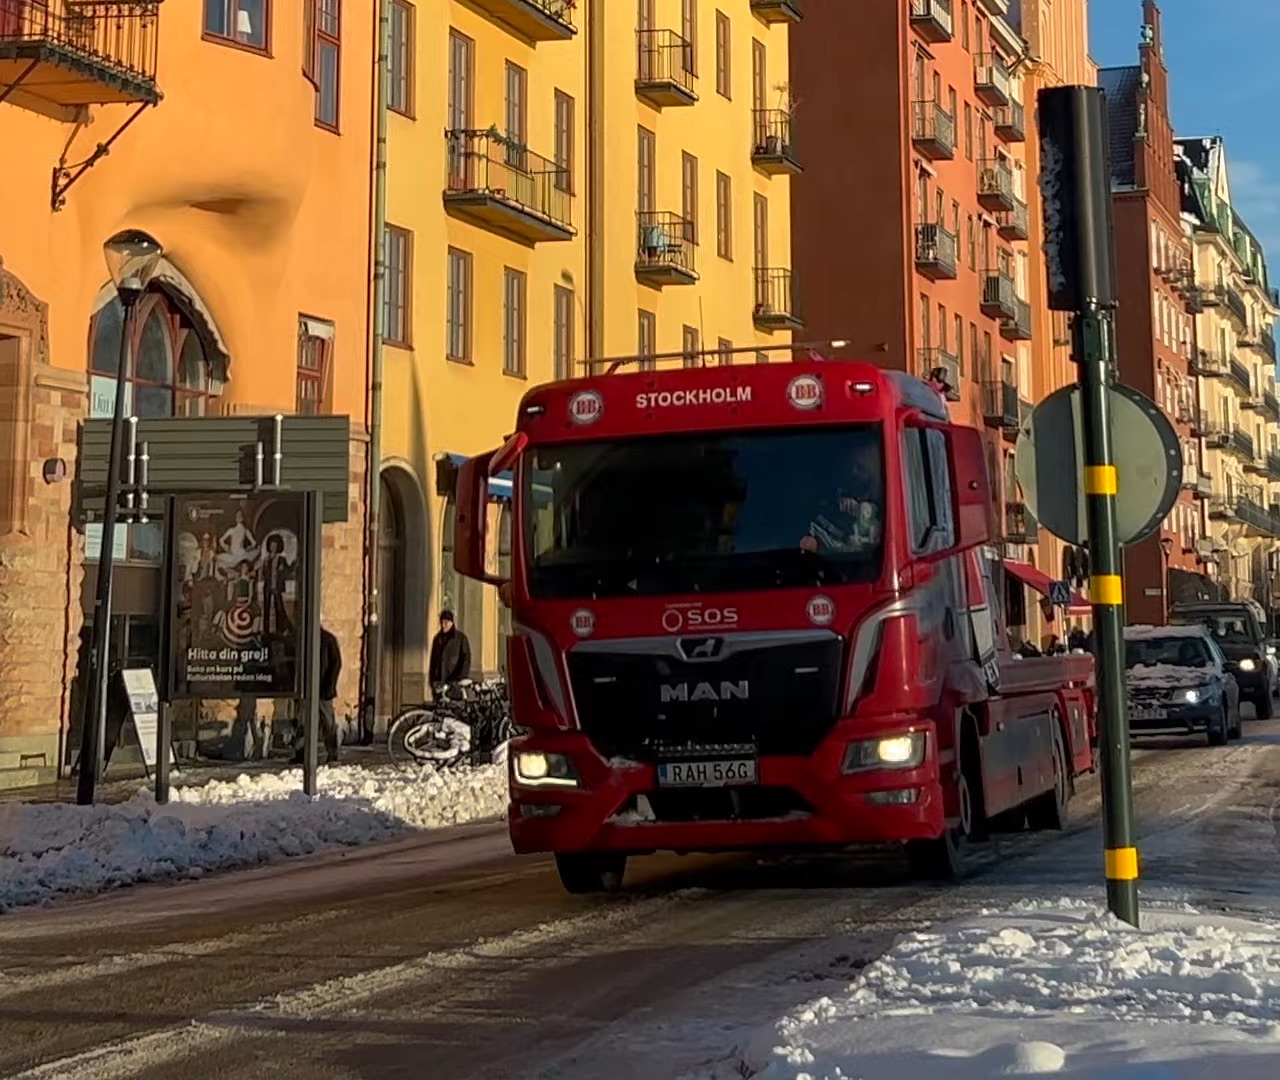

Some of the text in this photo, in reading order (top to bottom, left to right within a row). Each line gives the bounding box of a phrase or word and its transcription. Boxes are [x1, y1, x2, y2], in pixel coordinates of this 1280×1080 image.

[635, 386, 752, 408] STOCKHOLM
[687, 607, 738, 624] SOS
[187, 647, 269, 662] Hitta din grej!
[660, 680, 749, 702] MAN
[672, 762, 748, 781] RAH 56G
